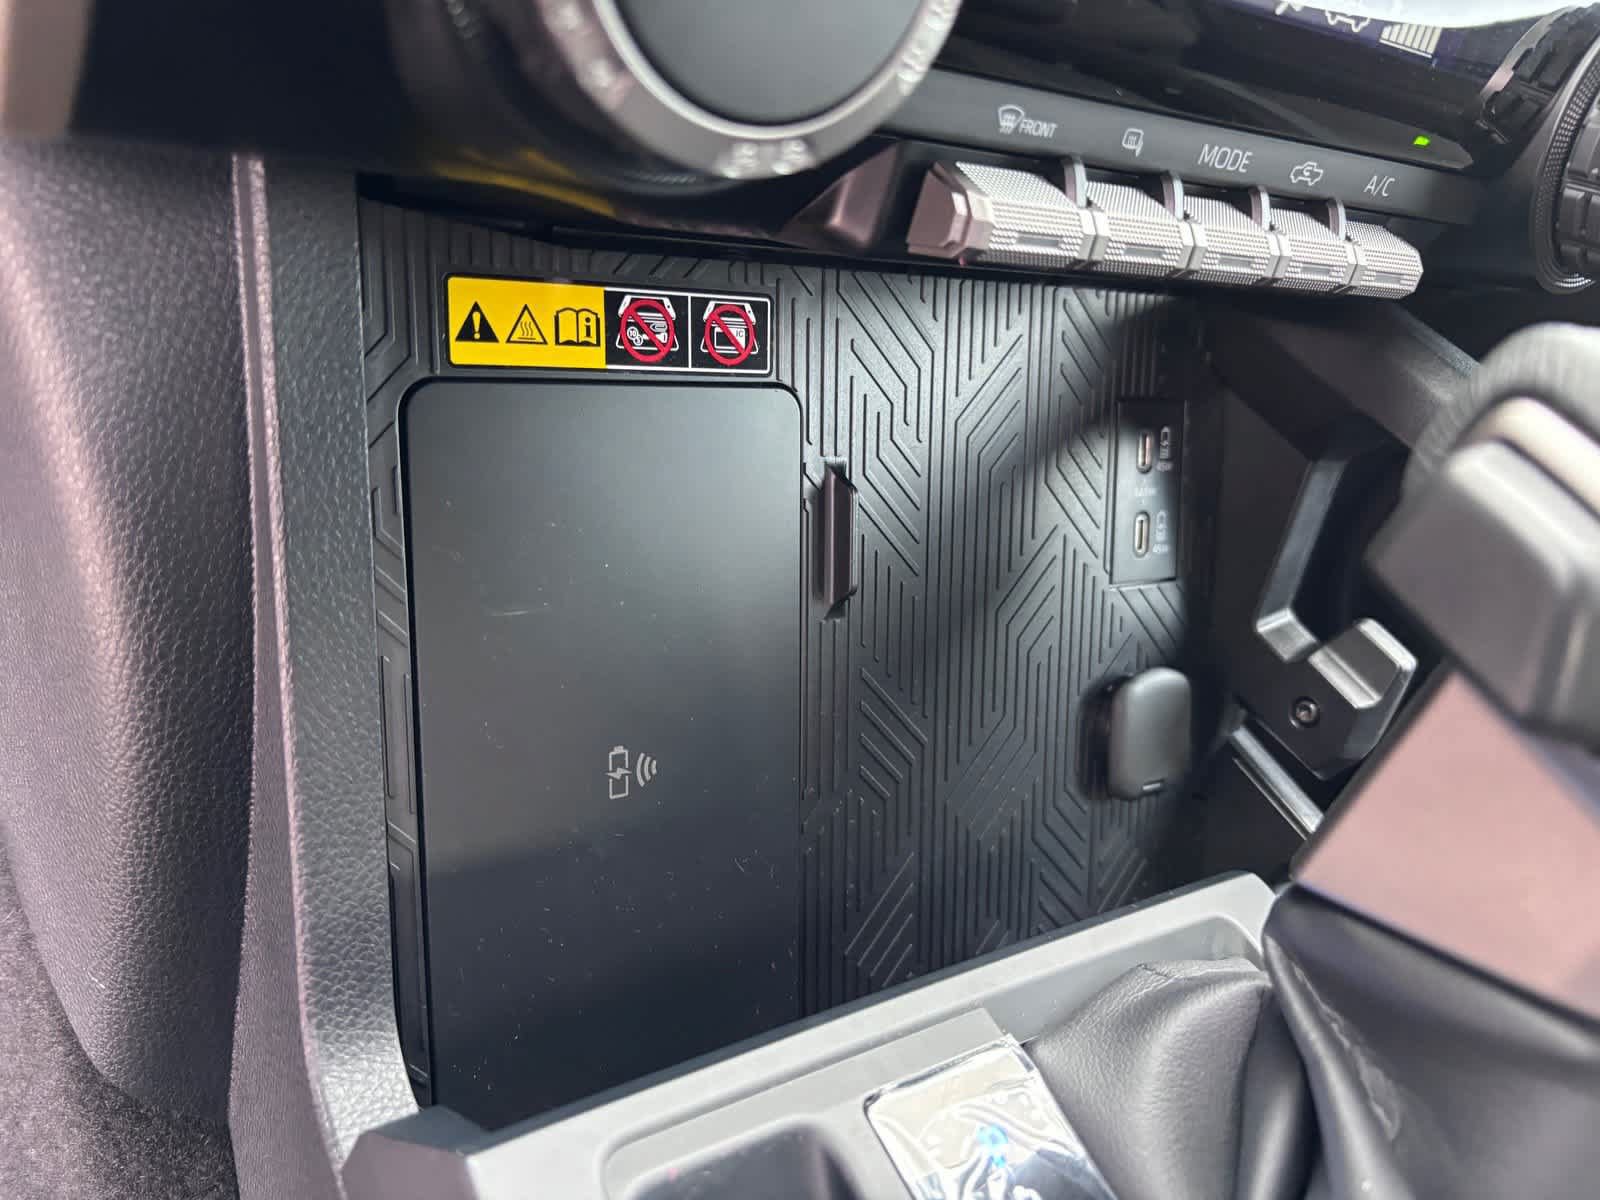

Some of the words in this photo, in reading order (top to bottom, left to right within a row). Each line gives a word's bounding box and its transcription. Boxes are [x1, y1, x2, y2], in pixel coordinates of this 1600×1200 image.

[1019, 119, 1057, 138] FRONT
[1198, 144, 1253, 172] MODE
[1363, 175, 1395, 197] A/C
